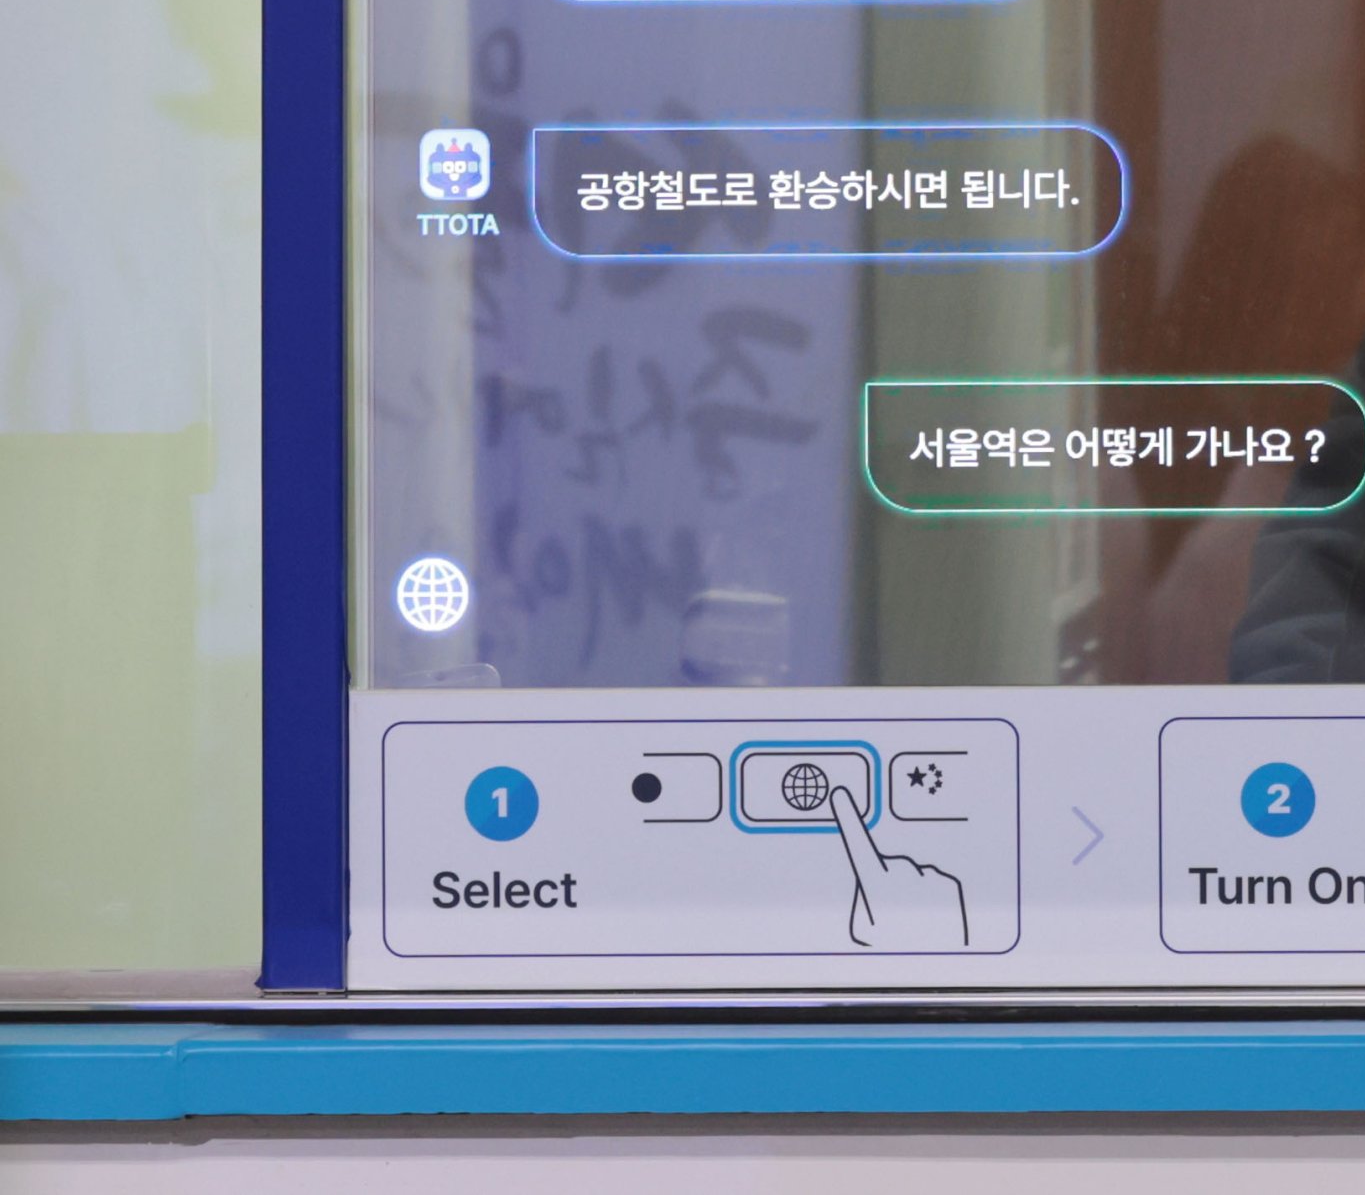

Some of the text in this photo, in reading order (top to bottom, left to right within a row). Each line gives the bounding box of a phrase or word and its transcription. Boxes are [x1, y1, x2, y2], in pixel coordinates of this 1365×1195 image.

[578, 169, 1078, 210] 공항철도로 환승하시면 됩니다.
[417, 214, 499, 235] TTOTA
[910, 428, 1055, 467] 서울역은
[1066, 427, 1172, 467] 어떻게
[493, 788, 507, 817] 1
[1268, 784, 1290, 813] 2
[433, 872, 577, 908] Select
[1189, 868, 1291, 904] Turn
